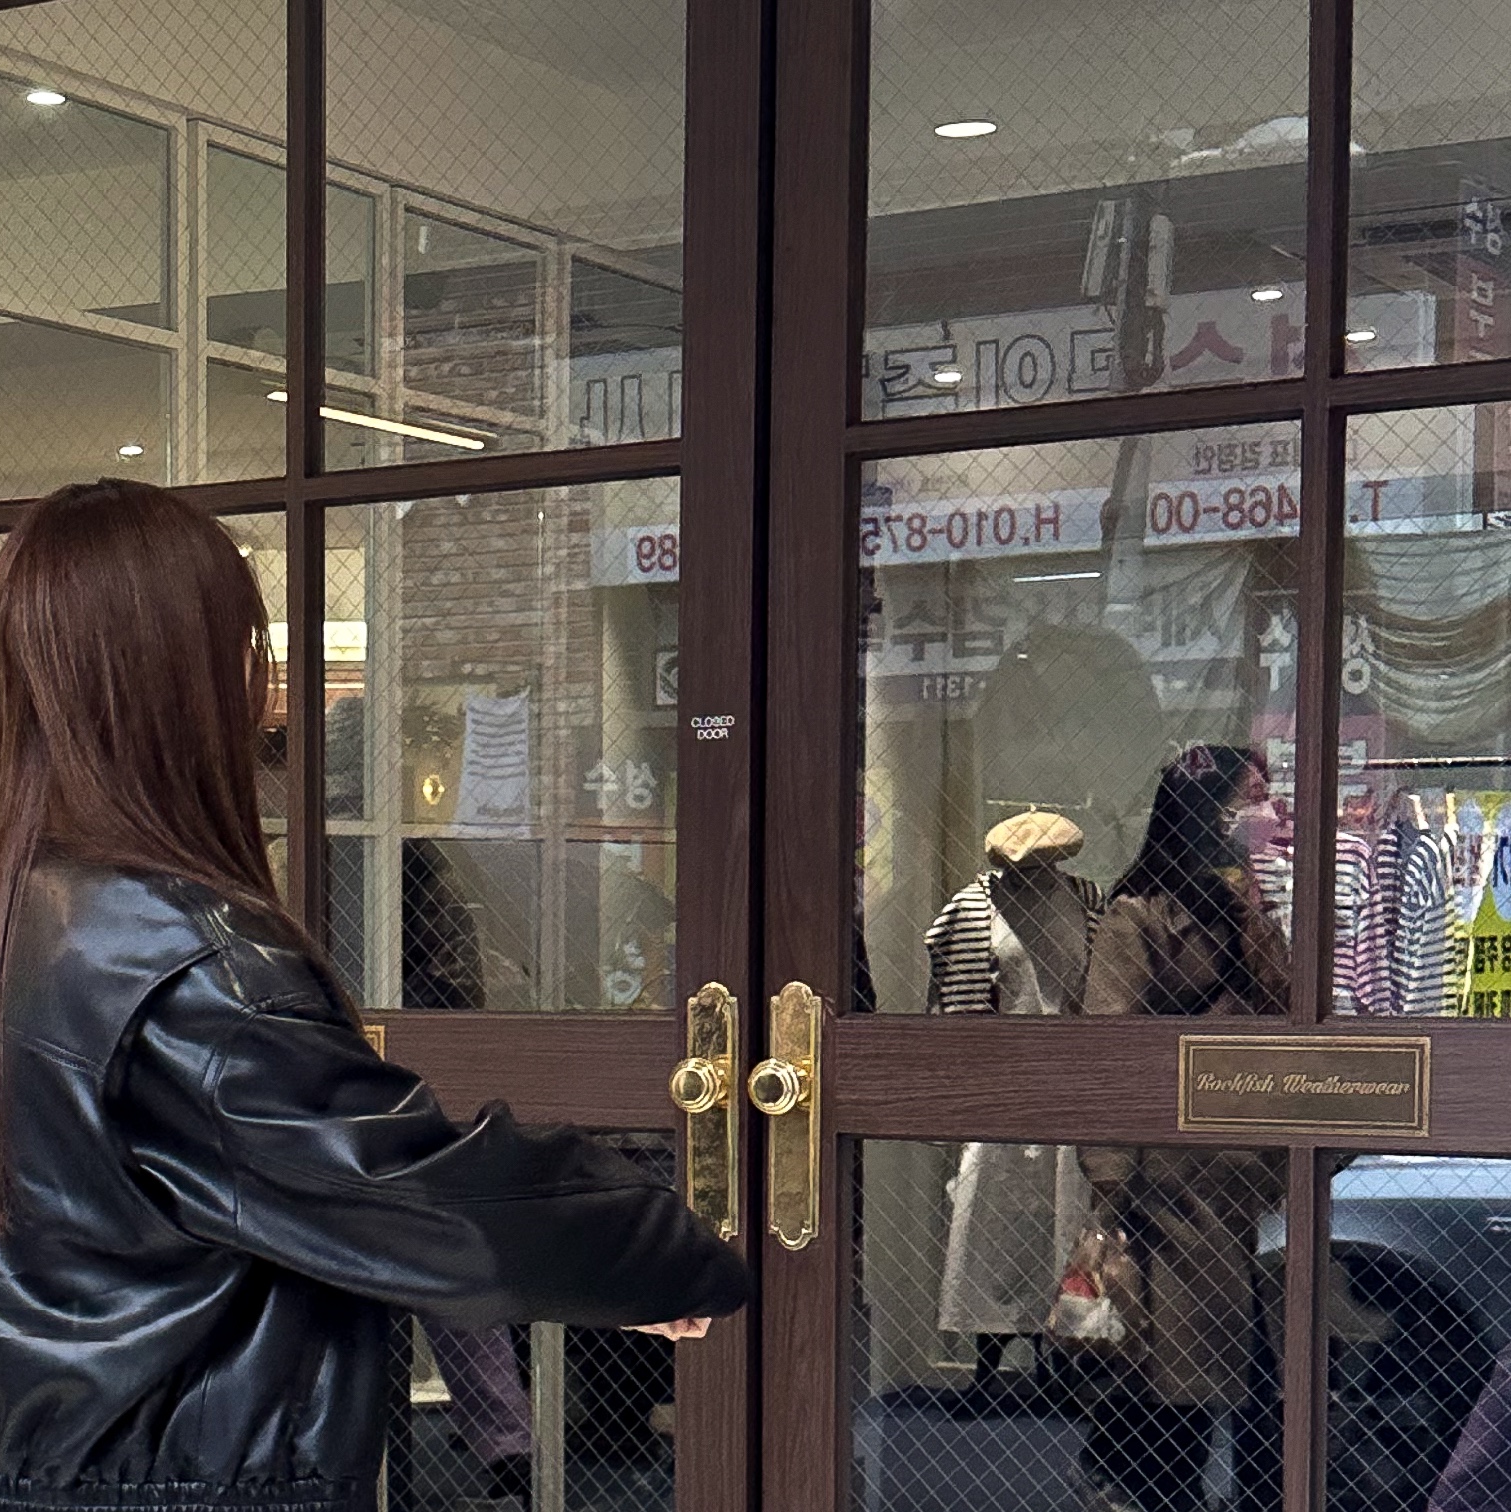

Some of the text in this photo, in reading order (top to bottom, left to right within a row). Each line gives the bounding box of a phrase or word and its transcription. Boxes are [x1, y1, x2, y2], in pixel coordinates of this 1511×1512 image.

[690, 715, 735, 728] CLOSED
[696, 727, 729, 740] DOOR
[1196, 1069, 1411, 1096] Rockfish Weatherwear
